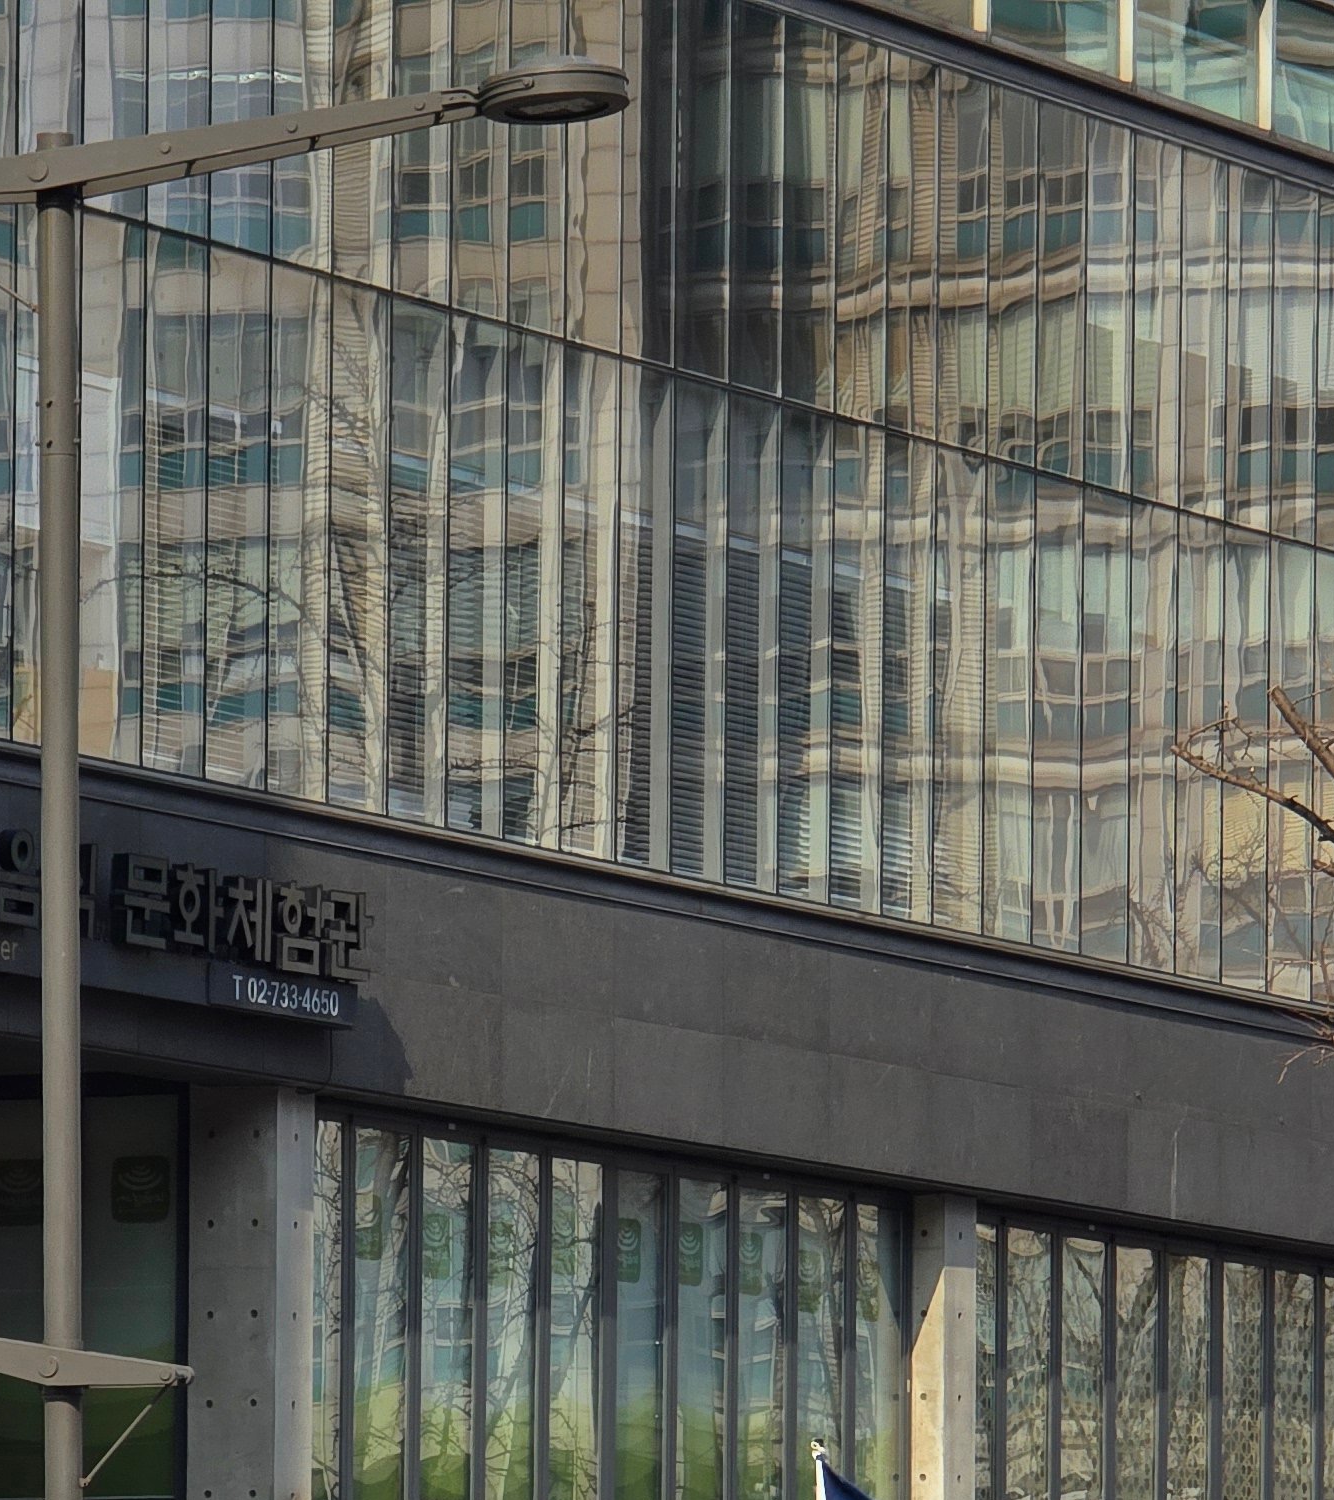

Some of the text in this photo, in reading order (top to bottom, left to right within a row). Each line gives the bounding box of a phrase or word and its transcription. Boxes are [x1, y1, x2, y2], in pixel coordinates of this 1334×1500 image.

[111, 852, 374, 981] 문화체험관
[232, 974, 340, 1017] T 02-733-4650
